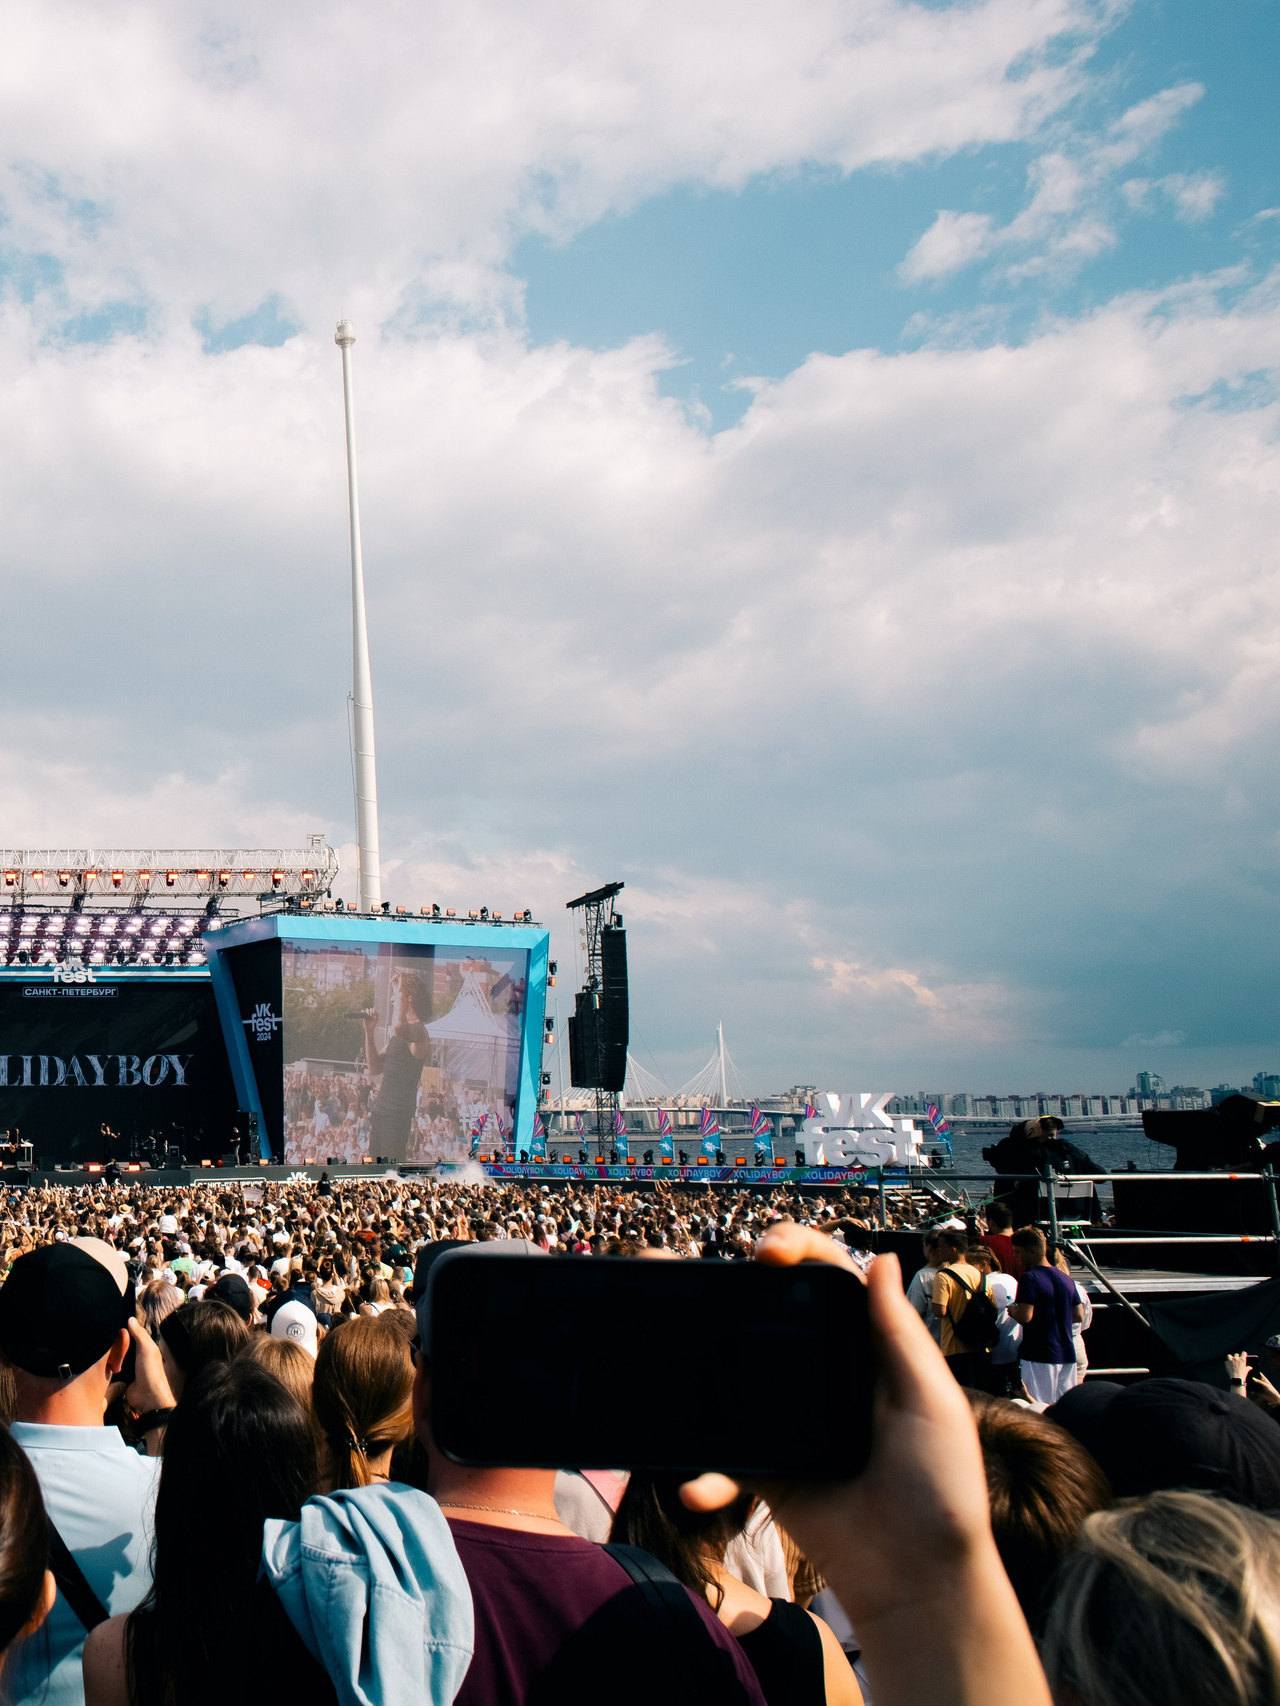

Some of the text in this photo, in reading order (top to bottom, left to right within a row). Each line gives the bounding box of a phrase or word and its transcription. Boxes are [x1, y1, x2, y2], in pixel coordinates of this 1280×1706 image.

[53, 967, 97, 984] fest
[24, 988, 117, 996] САНКТ-ПЕТЕРБУРГ
[255, 1003, 272, 1017] VK
[250, 1013, 279, 1032] fest
[256, 1032, 272, 1041] 2024
[817, 1092, 896, 1128] VK
[795, 1117, 928, 1167] fest
[290, 1171, 308, 1181] VK
[804, 1170, 869, 1181] XOLIDAYBOY
